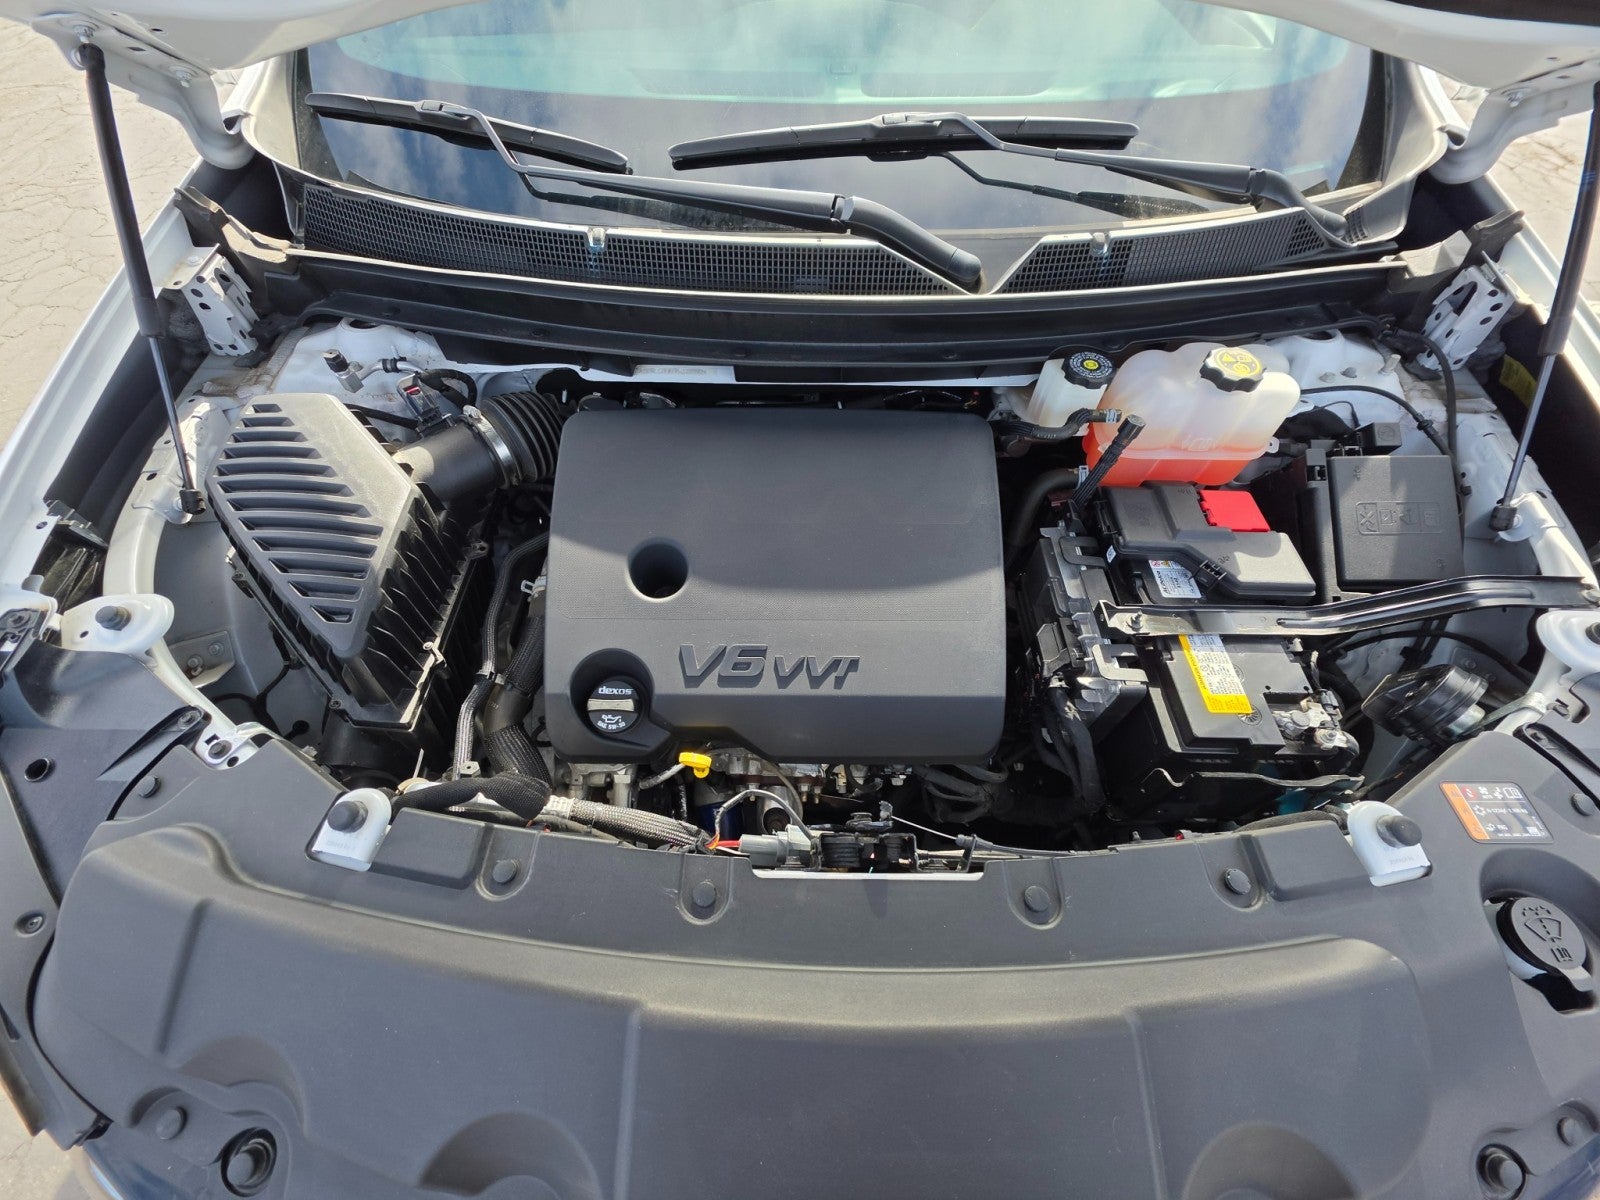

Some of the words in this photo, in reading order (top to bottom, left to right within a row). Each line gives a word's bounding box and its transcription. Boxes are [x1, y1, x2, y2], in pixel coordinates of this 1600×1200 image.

[678, 643, 769, 689] V6
[774, 655, 861, 690] VVT
[598, 685, 634, 695] dexos
